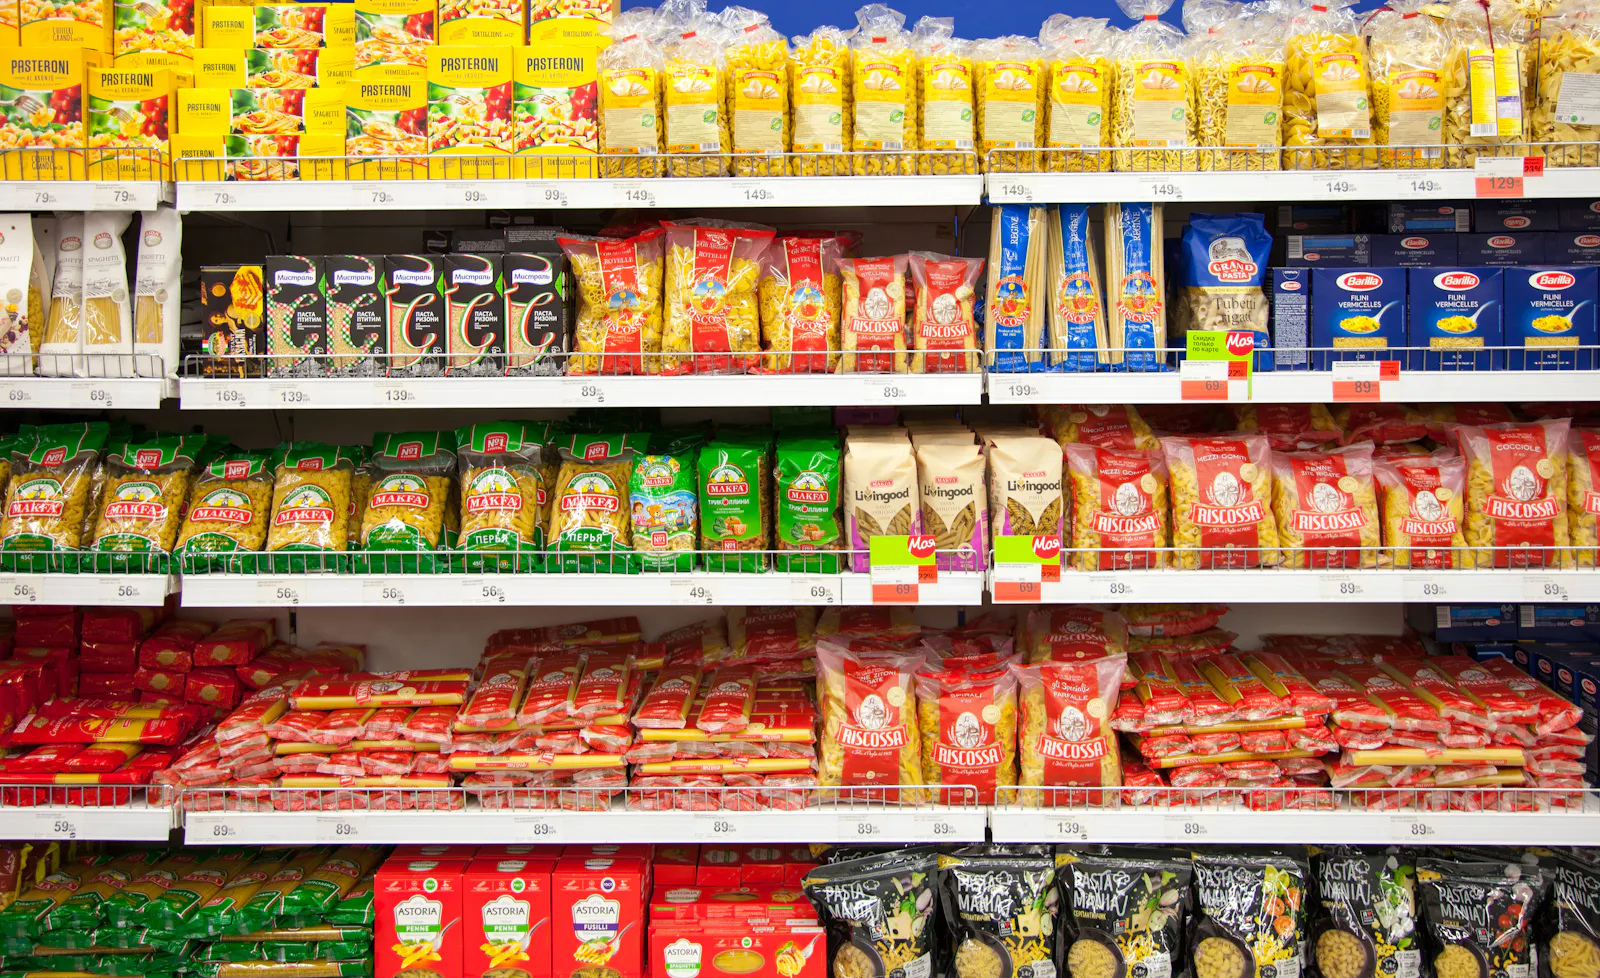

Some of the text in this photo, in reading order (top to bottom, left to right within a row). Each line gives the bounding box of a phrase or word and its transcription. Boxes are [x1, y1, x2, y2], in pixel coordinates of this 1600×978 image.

[212, 21, 245, 29] PASTERONI
[11, 60, 69, 76] PASTERONI
[204, 64, 236, 73] PASTERONI
[441, 58, 498, 72] PASTERONI
[527, 58, 584, 72] PASTERONI
[327, 70, 353, 78] SPAGHETTI
[101, 74, 153, 88] PASTERONI
[362, 85, 411, 98] PASTERONI
[187, 104, 221, 113] PASTERONI
[313, 110, 339, 118] SPAGHETTI
[182, 150, 215, 158] PASTERONI
[1326, 182, 1348, 192] 149
[1411, 181, 1433, 192] 149
[1489, 177, 1514, 189] 129
[744, 190, 766, 200] 149
[1002, 185, 1024, 196] 149
[1152, 184, 1174, 195] 149
[36, 192, 49, 203] 79
[115, 191, 129, 202] 79
[215, 193, 229, 204] 79
[372, 192, 386, 203] 79
[465, 192, 479, 202] 99
[545, 190, 559, 201] 99
[626, 191, 648, 201] 149
[1212, 263, 1254, 272] GRAND
[277, 273, 314, 282] Мистраль
[336, 273, 373, 282] Мистраль
[396, 273, 432, 282] Мистраль
[455, 273, 491, 282] Мистраль
[514, 272, 550, 281] Мистраль
[1344, 275, 1380, 286] Barilla
[1442, 275, 1477, 286] Barilla
[1538, 275, 1574, 286] Barilla
[1213, 297, 1256, 310] Tubetti
[686, 304, 732, 324] RISCOSSA
[991, 307, 1031, 327] RISCOSSA
[1060, 306, 1099, 323] RISCOSSA
[1117, 303, 1162, 323] RISCOSSA
[1221, 311, 1252, 326] rigati
[604, 315, 648, 333] RISCOSSA
[853, 320, 899, 333] RISCOSSA
[923, 325, 968, 337] RISCOSSA
[1227, 335, 1254, 348] Моя
[582, 387, 596, 396] 89
[1009, 385, 1031, 395] 199
[1206, 381, 1219, 391] 69
[1355, 382, 1371, 393] 89
[10, 391, 23, 400] 69
[91, 391, 104, 400] 69
[216, 391, 237, 402] 169
[281, 392, 303, 402] 139
[386, 390, 407, 400] 139
[884, 388, 898, 397] 89
[1497, 444, 1540, 452] COCCIOLE
[710, 485, 745, 493] MAKFA
[924, 485, 973, 500] Livingood
[1008, 480, 1060, 494] Livingood
[374, 494, 423, 503] MAKFA
[791, 492, 825, 501] MAKFA
[856, 488, 909, 503] Livingood
[12, 502, 57, 513] MAKFA
[470, 497, 518, 508] MAKFA
[565, 497, 613, 508] MAKFA
[110, 505, 154, 516] MAKFA
[1492, 501, 1556, 517] RISCOSSA
[196, 510, 245, 521] MAKFA
[280, 509, 328, 522] MAKFA
[1199, 507, 1260, 523] RISCOSSA
[1100, 517, 1155, 531] RISCOSSA
[1300, 514, 1360, 530] RISCOSSA
[1406, 521, 1456, 534] RISCOSSA
[476, 534, 508, 544] ПЕРЬЯ
[569, 534, 603, 542] ПЕРЬЯ
[909, 538, 936, 550] Моя
[1033, 538, 1060, 550] Моя
[14, 585, 28, 595] 56
[119, 586, 132, 596] 56
[483, 587, 497, 597] 56
[690, 587, 705, 598] 49
[811, 586, 825, 597] 69
[896, 585, 910, 594] 69
[1020, 582, 1033, 592] 69
[1110, 583, 1124, 594] 89
[1341, 584, 1354, 594] 89
[1424, 585, 1438, 595] 89
[1545, 585, 1559, 595] 89
[277, 588, 292, 598] 56
[383, 588, 397, 598] 56
[1062, 681, 1089, 692] Speciali
[843, 730, 901, 746] RISCOSSA
[1043, 741, 1102, 758] RISCOSSA
[939, 750, 997, 766] RISCOSSA
[54, 822, 68, 832] 59
[214, 825, 228, 836] 89
[336, 824, 350, 835] 89
[534, 824, 548, 835] 89
[714, 822, 728, 832] 89
[858, 823, 873, 834] 89
[934, 823, 948, 834] 89
[1057, 822, 1079, 833] 139
[1185, 824, 1199, 835] 89
[1412, 824, 1426, 835] 89
[1320, 860, 1355, 880] PASTA
[1074, 870, 1111, 891] PASTA
[1199, 867, 1232, 886] PASTA
[826, 881, 863, 902] PASTA
[1320, 881, 1370, 905] MANIA
[1440, 887, 1471, 903] PASTA
[1442, 904, 1486, 926] MANIA
